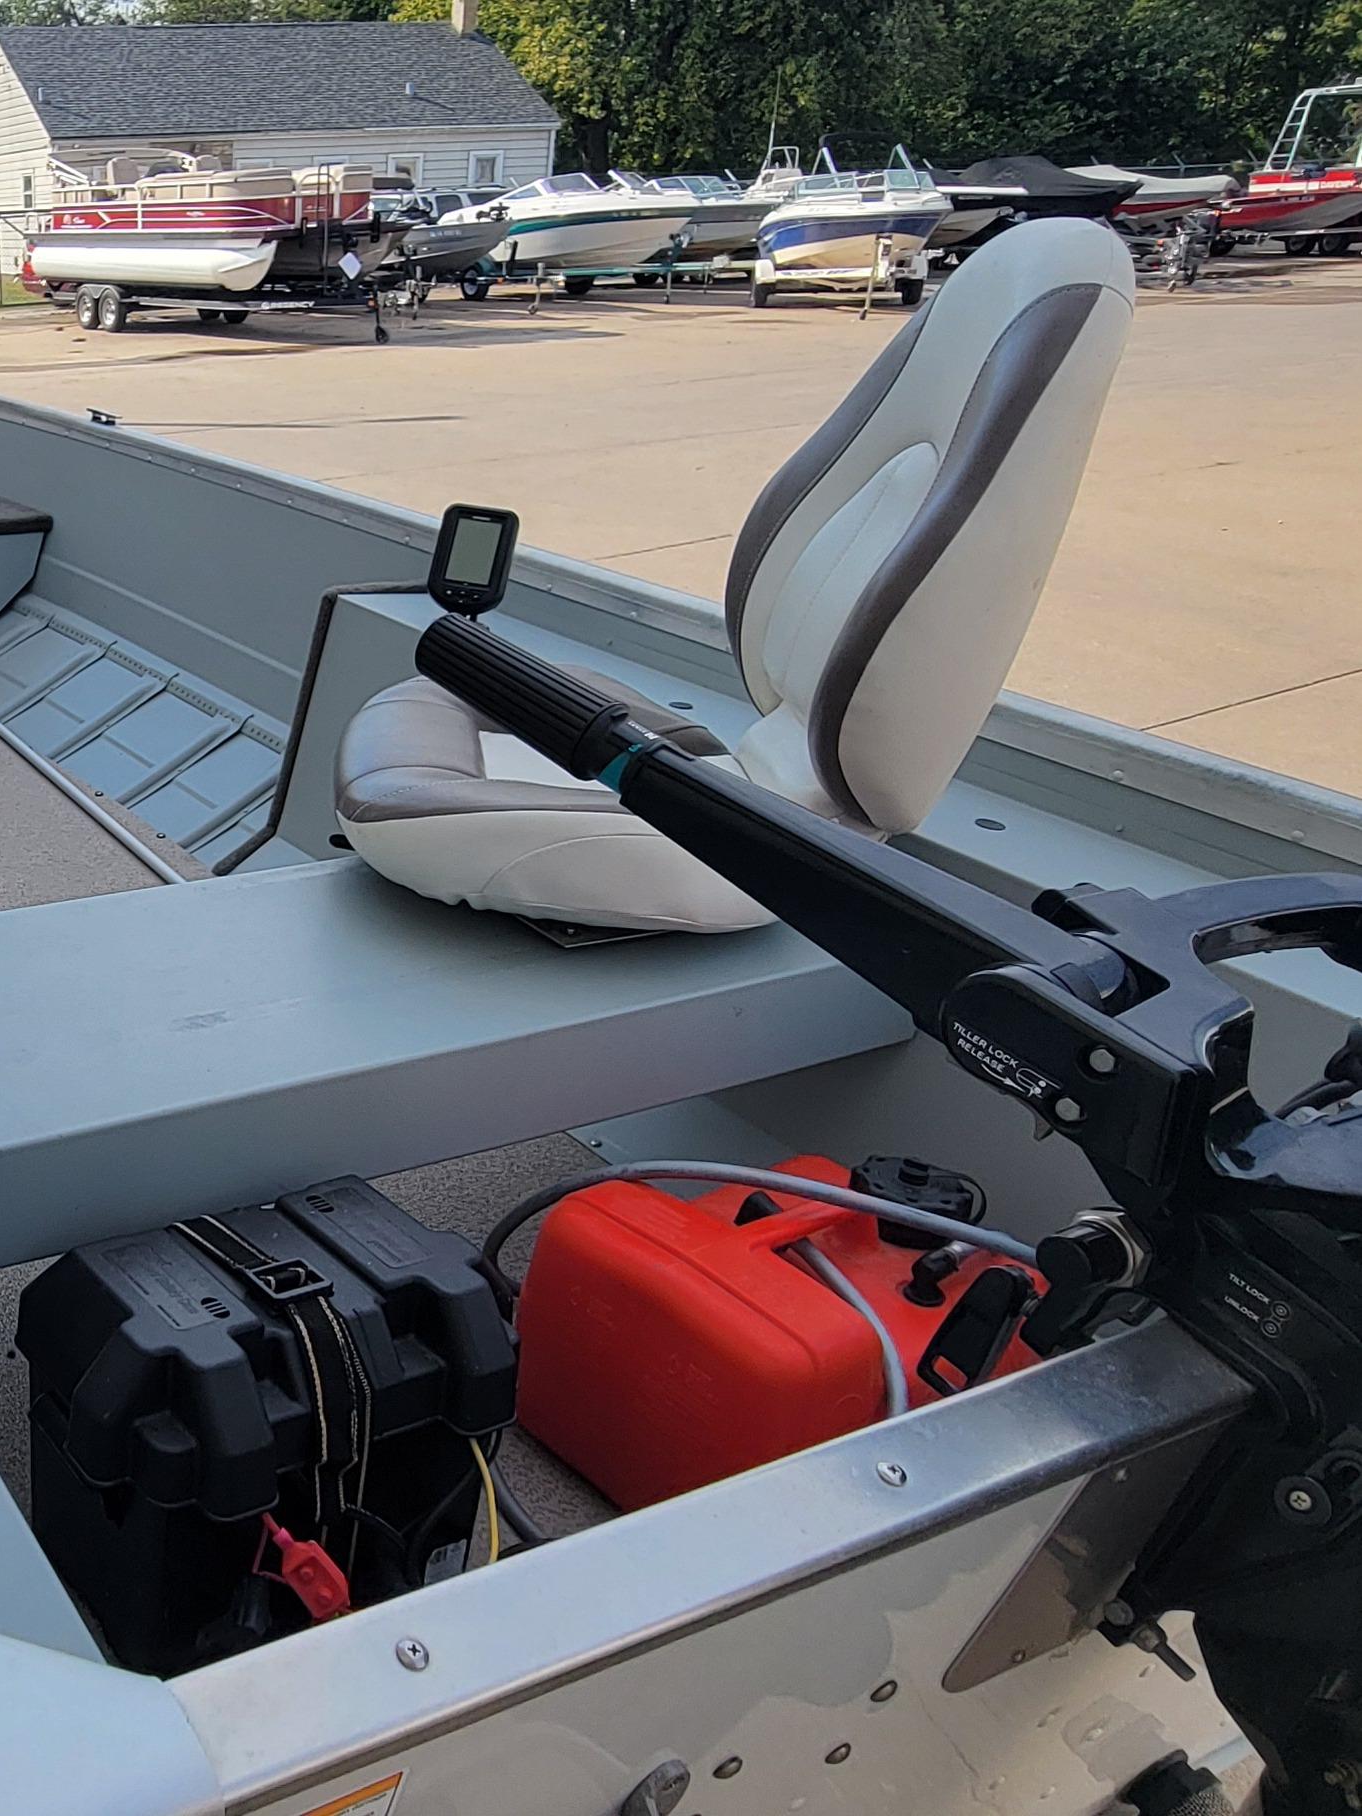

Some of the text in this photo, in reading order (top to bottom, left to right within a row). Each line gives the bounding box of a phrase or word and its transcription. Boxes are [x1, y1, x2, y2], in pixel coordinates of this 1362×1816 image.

[953, 1021, 1019, 1068] TILLER LOCK
[957, 1038, 1005, 1073] RELEASE
[1229, 1273, 1270, 1304] TILT LOCK
[1224, 1295, 1260, 1323] UNLOCK
